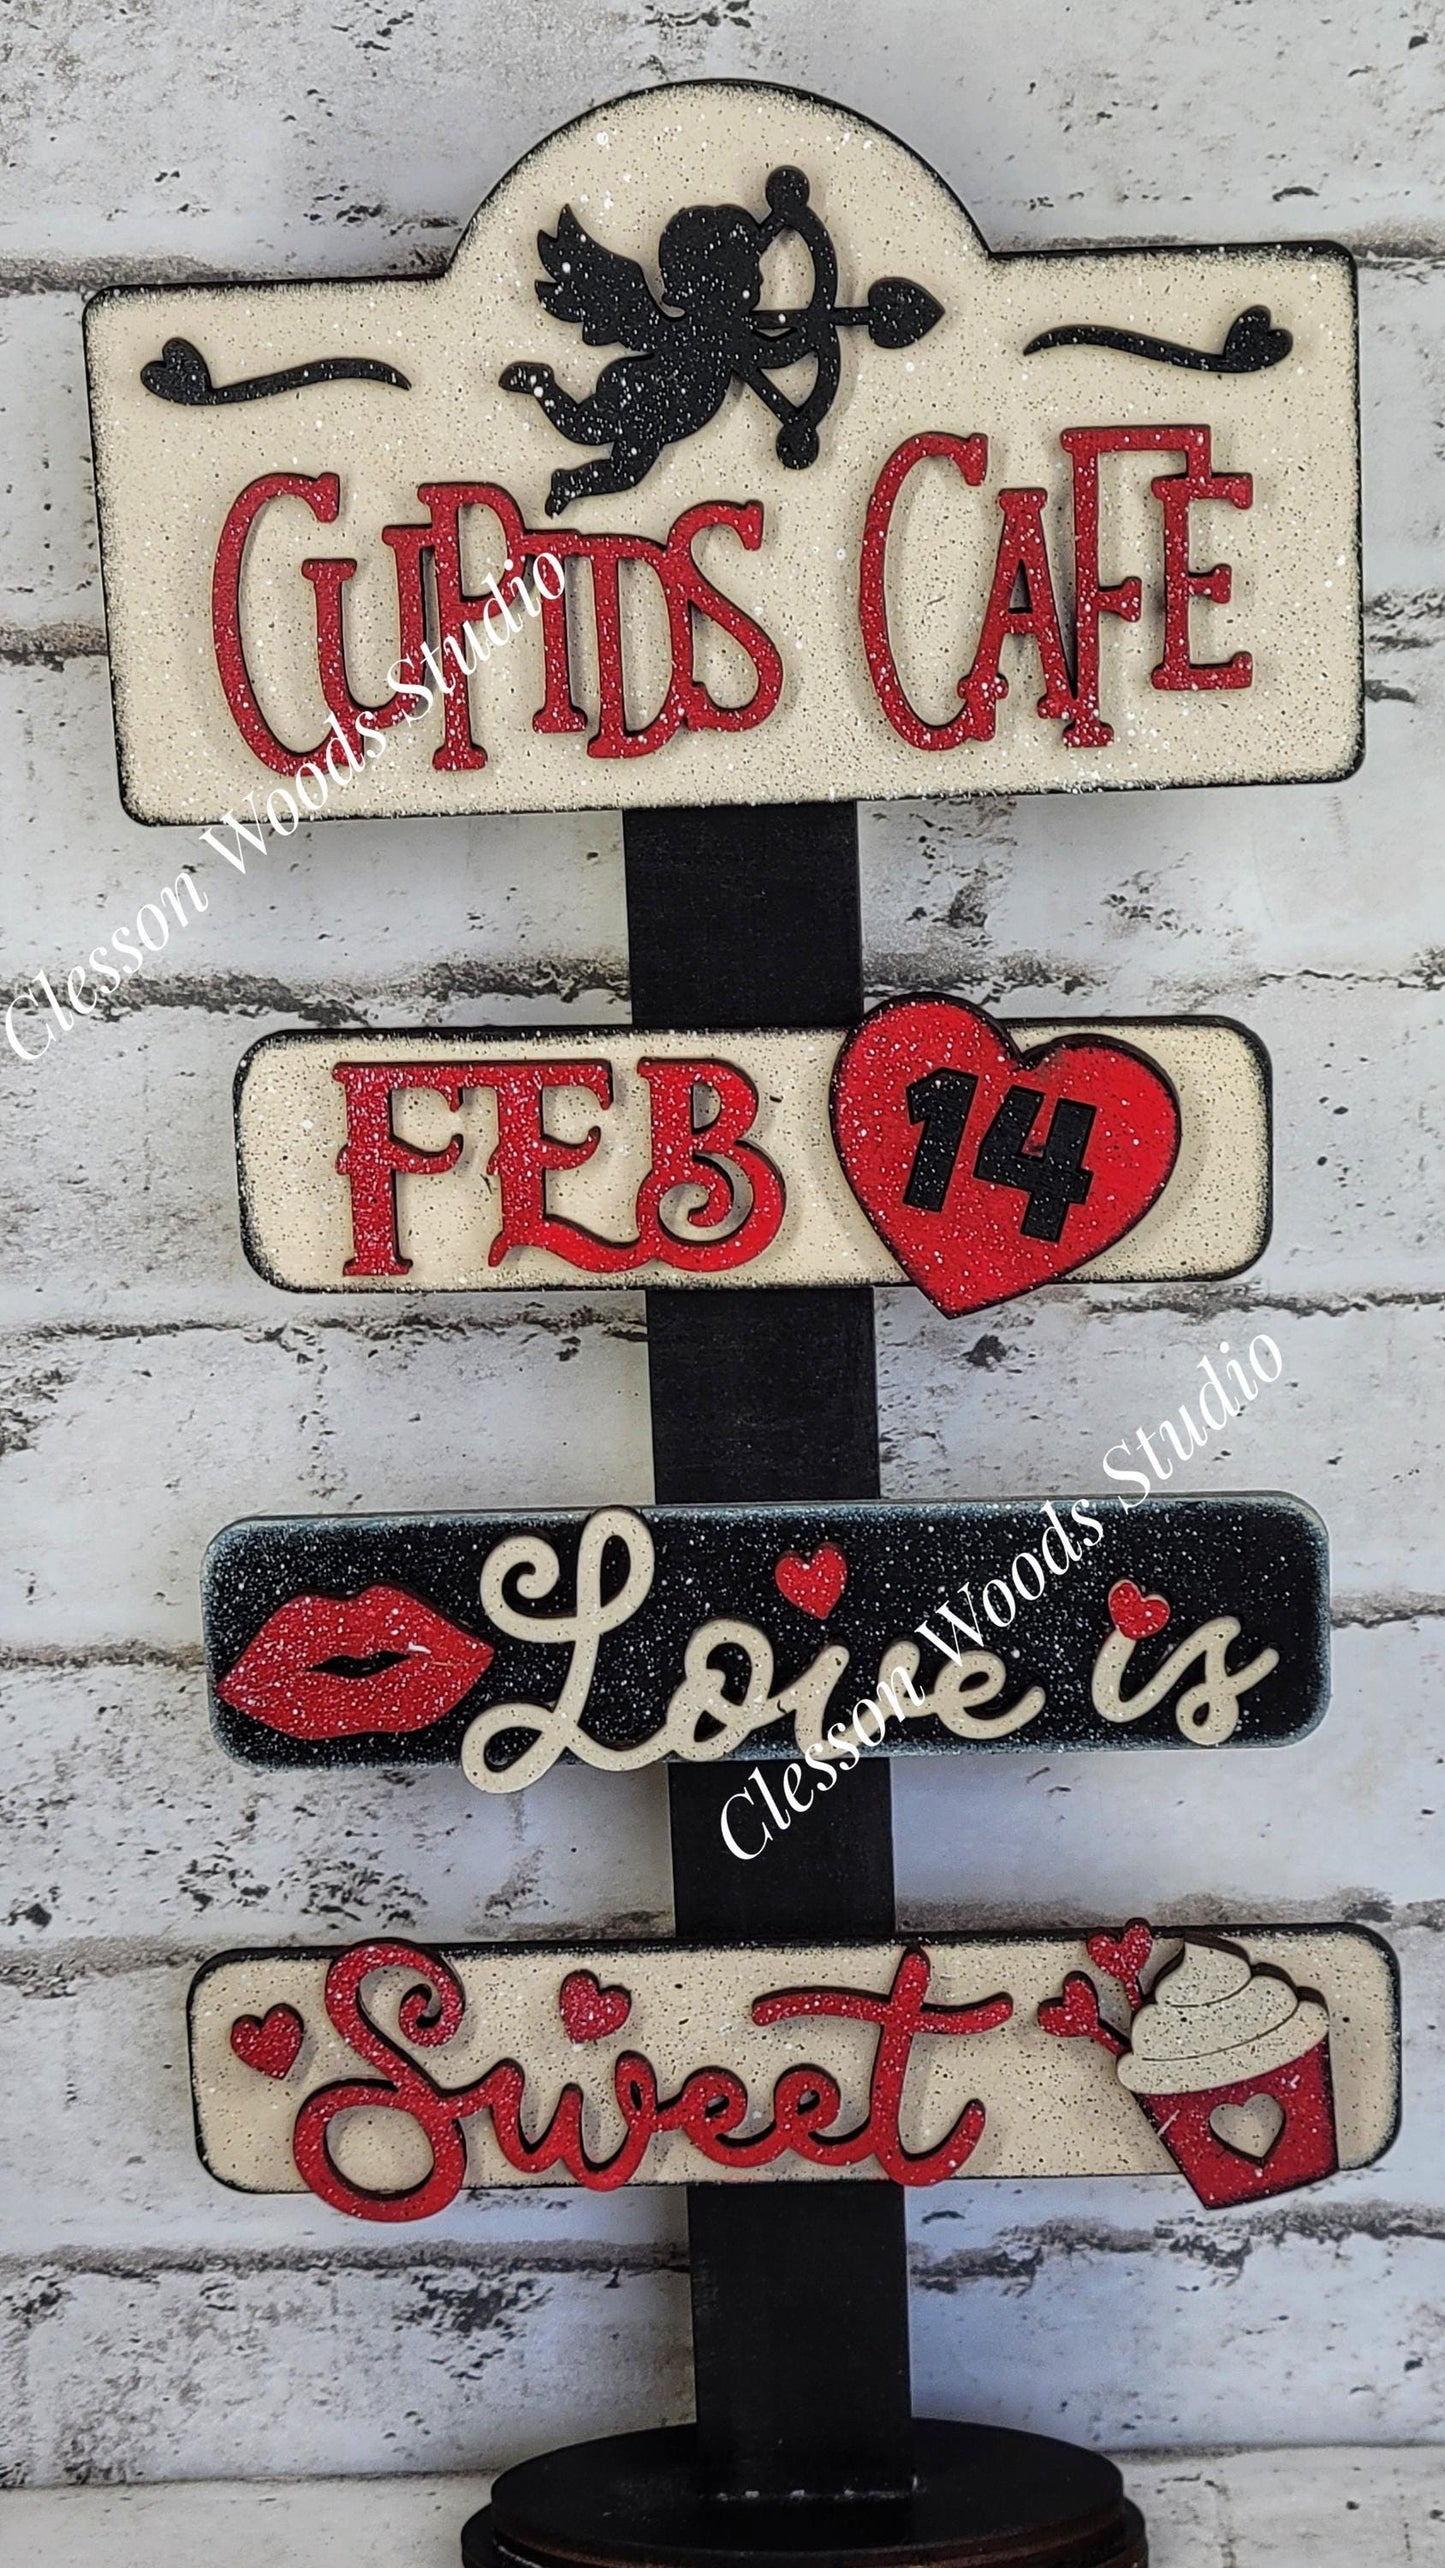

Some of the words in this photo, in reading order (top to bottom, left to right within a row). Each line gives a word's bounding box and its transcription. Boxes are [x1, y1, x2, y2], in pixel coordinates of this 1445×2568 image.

[860, 425, 1253, 752] CAFE
[331, 1056, 788, 1277] FEB
[900, 1067, 1097, 1243] 14
[461, 1505, 1046, 1795] Love
[1091, 1579, 1280, 1745] is
[292, 1938, 1014, 2223] Sweet
